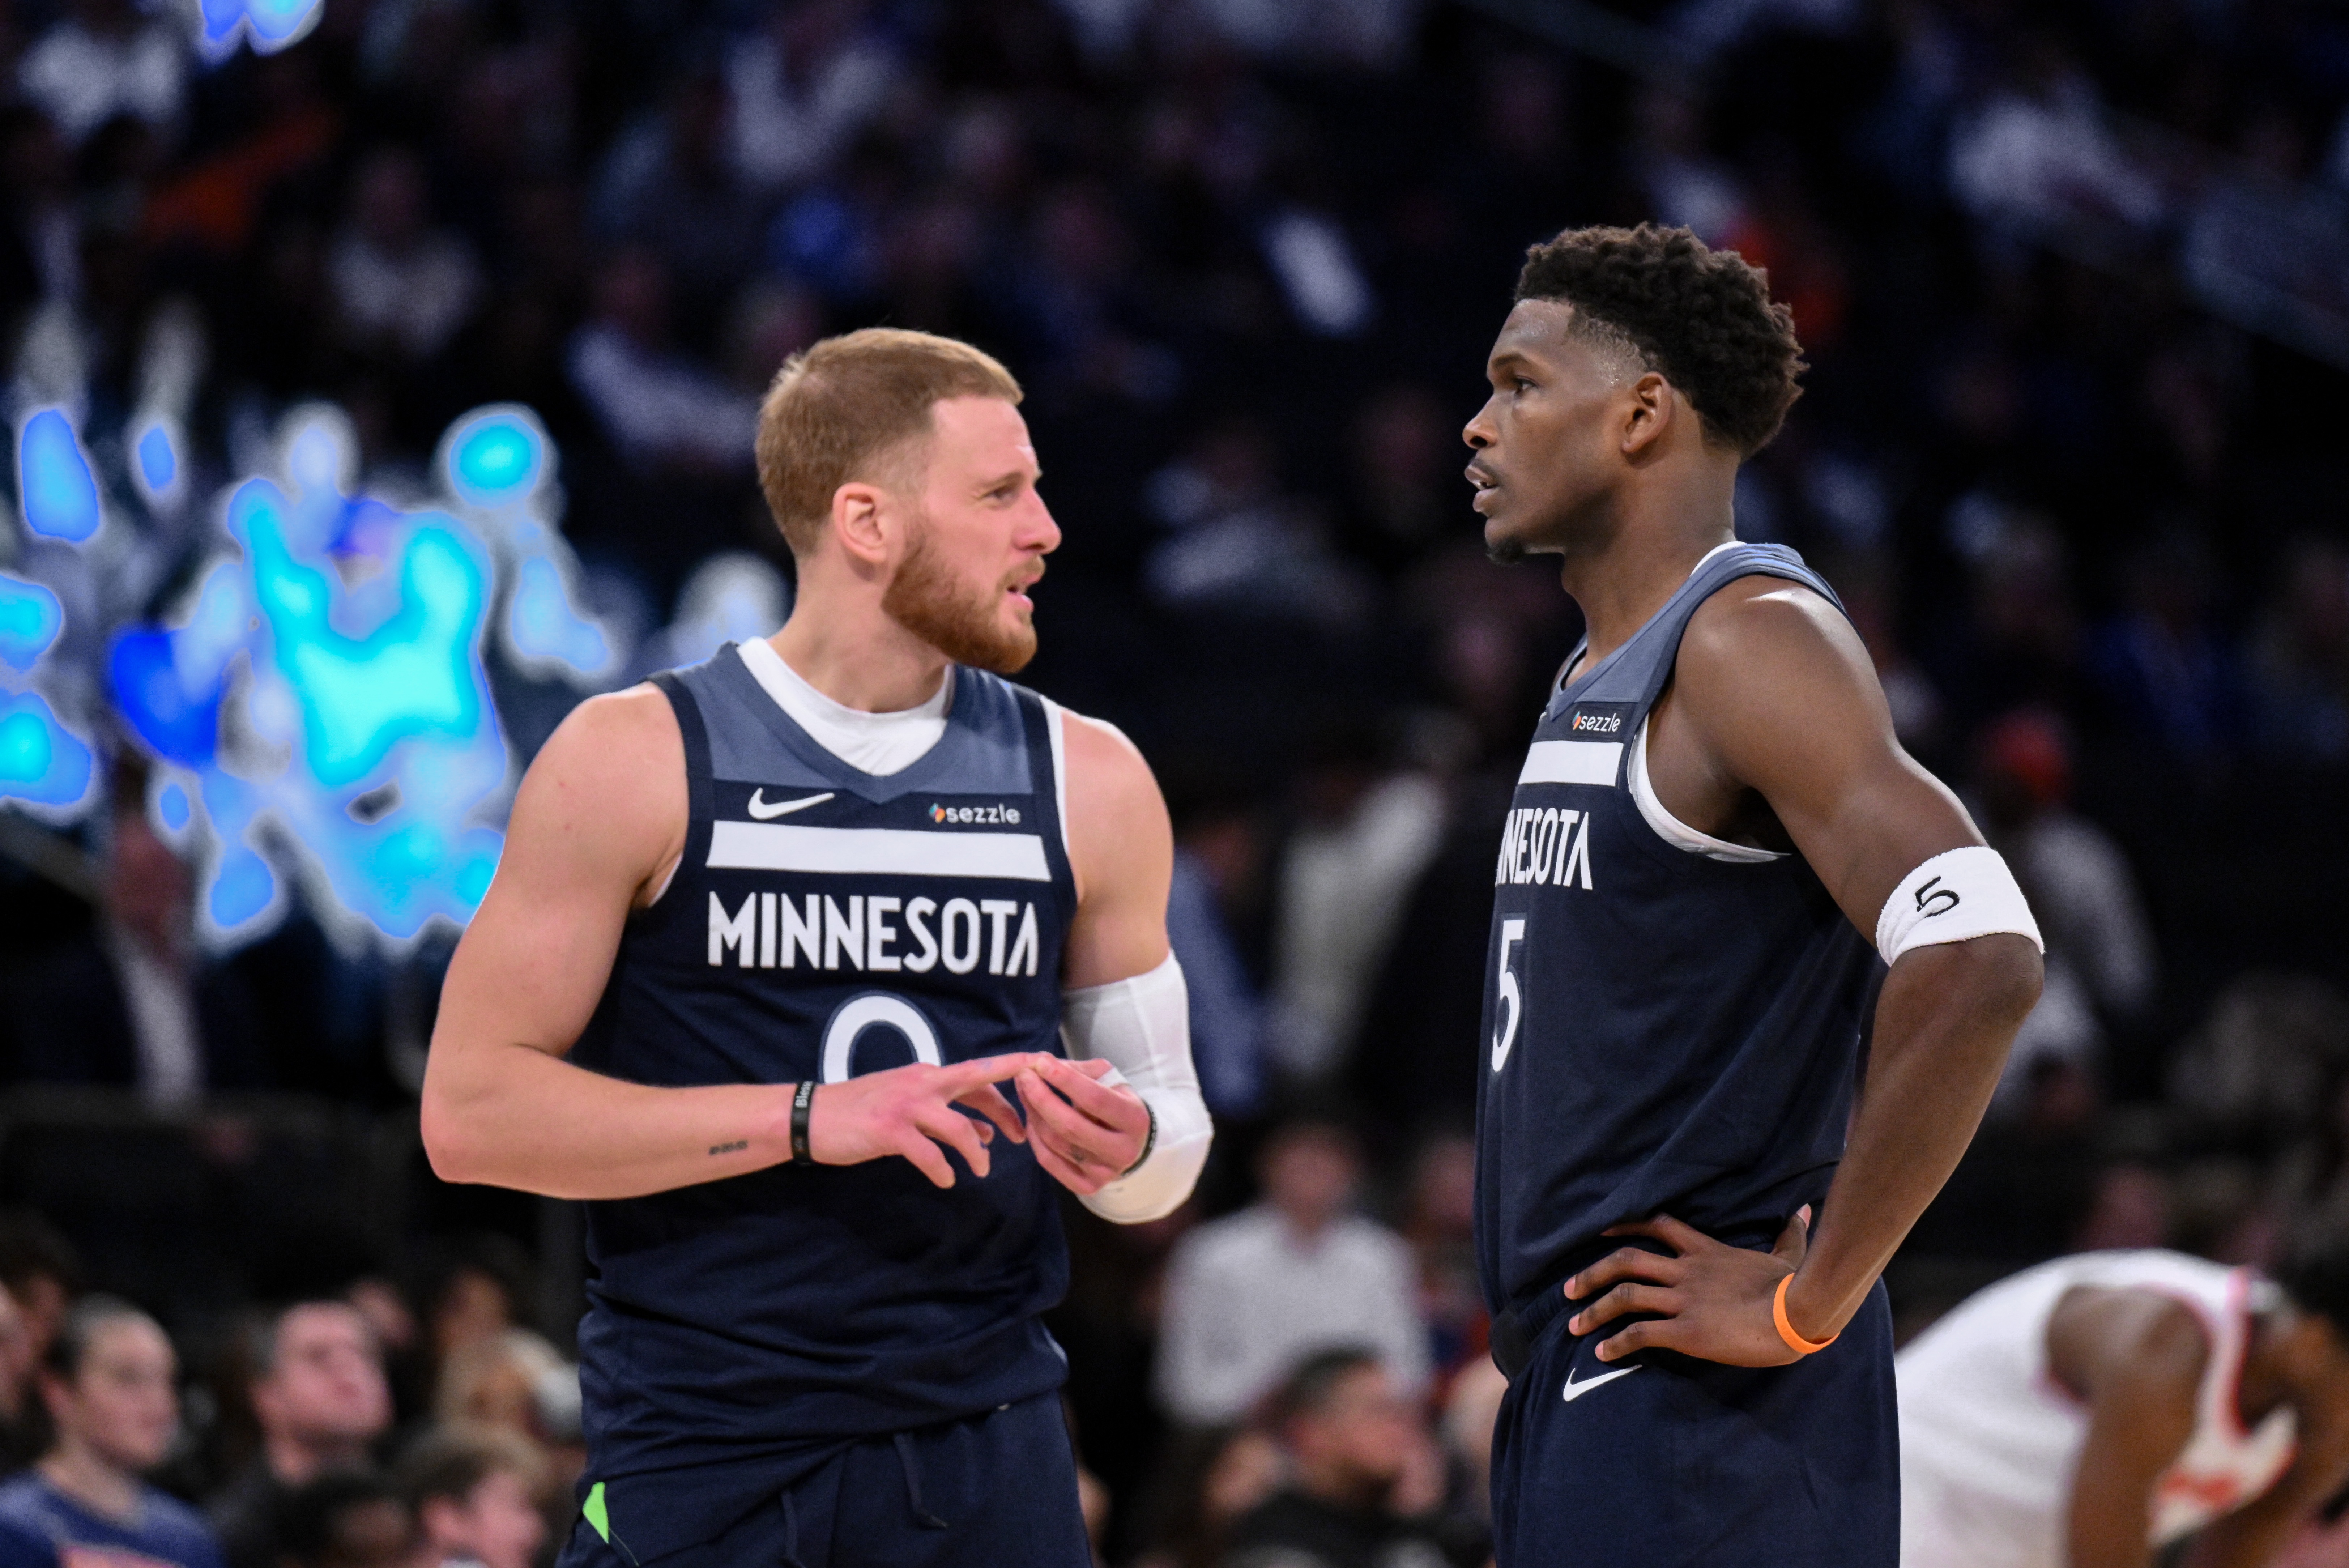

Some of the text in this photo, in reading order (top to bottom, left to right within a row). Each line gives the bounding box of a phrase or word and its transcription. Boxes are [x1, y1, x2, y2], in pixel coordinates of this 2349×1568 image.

[1579, 712, 1621, 732] sezzle
[945, 803, 1020, 824] sezzle
[1914, 875, 1960, 918] 5
[708, 891, 1039, 976] MINNESOTA
[1492, 919, 1525, 1073] 5
